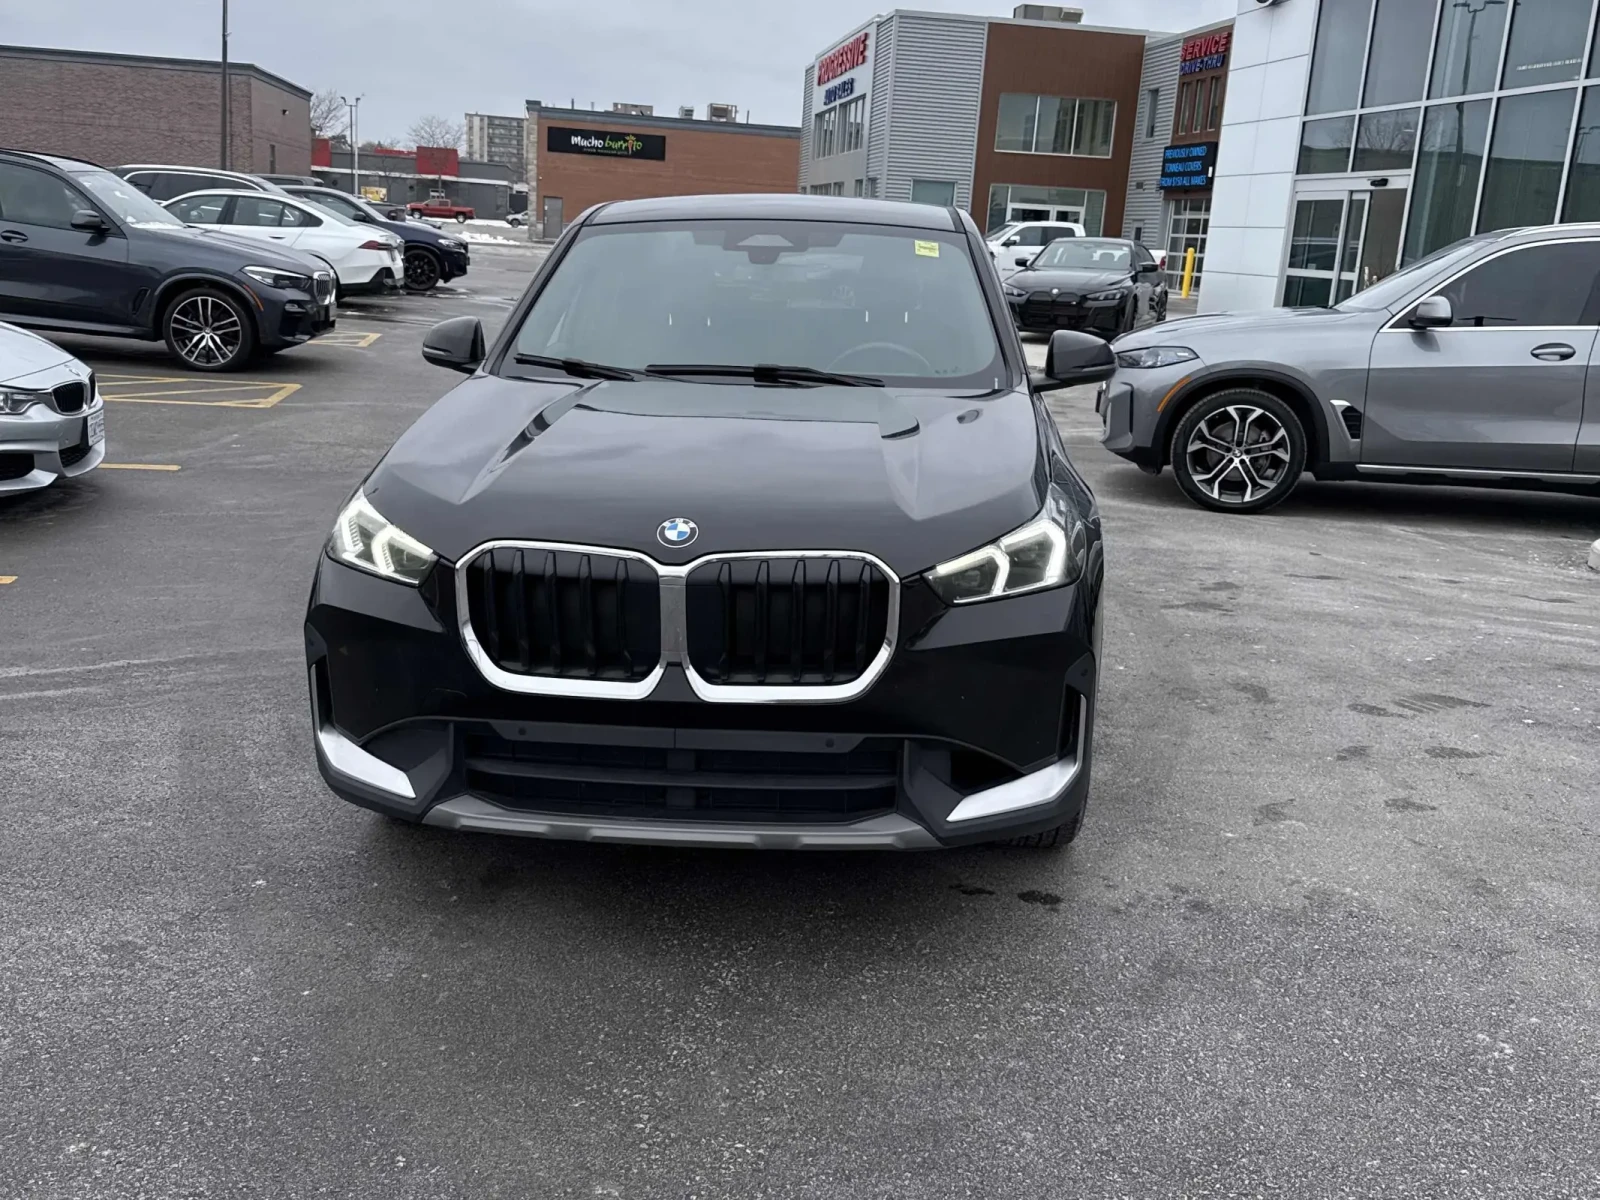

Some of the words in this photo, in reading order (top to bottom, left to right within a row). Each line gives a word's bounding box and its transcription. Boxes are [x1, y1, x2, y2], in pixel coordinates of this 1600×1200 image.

[1181, 32, 1229, 61] SERVICE
[570, 136, 604, 148] Mucho
[605, 134, 643, 155] burrito
[1189, 145, 1208, 157] OWNED
